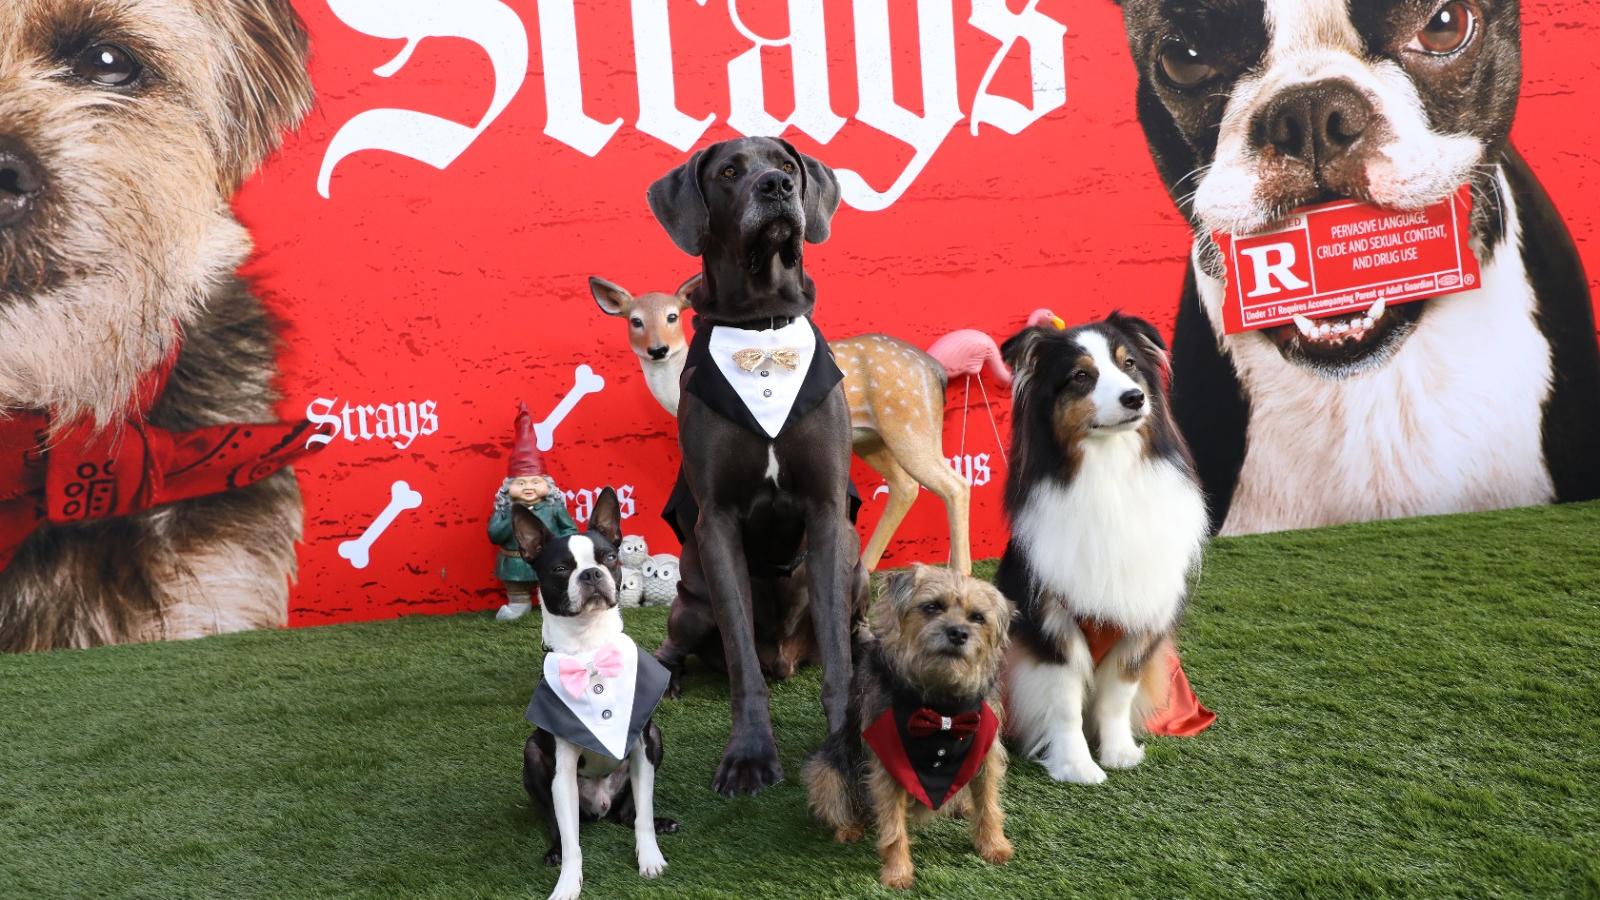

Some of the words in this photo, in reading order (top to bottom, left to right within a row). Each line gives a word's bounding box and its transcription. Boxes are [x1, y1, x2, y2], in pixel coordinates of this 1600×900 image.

[317, 0, 1067, 211] Strays
[1316, 242, 1348, 260] CRUDE
[1348, 238, 1369, 254] AND
[1369, 232, 1403, 250] SEXUAL
[1403, 224, 1447, 244] CONTENT,
[1331, 219, 1377, 239] PERVASIVE
[1378, 210, 1429, 231] LANGUAGE,
[1240, 242, 1309, 298] R
[1352, 254, 1373, 271] AND
[1373, 249, 1400, 268] DRUG
[1400, 246, 1418, 262] USE
[1245, 309, 1266, 321] Under
[1267, 306, 1276, 317] 17
[1278, 302, 1307, 315] Requires
[1307, 293, 1354, 310] Accompanying
[1355, 289, 1376, 301] Parent
[1377, 288, 1385, 297] or
[1385, 283, 1403, 296] Adult
[1404, 278, 1434, 292] Guardian
[305, 397, 439, 450] Strays
